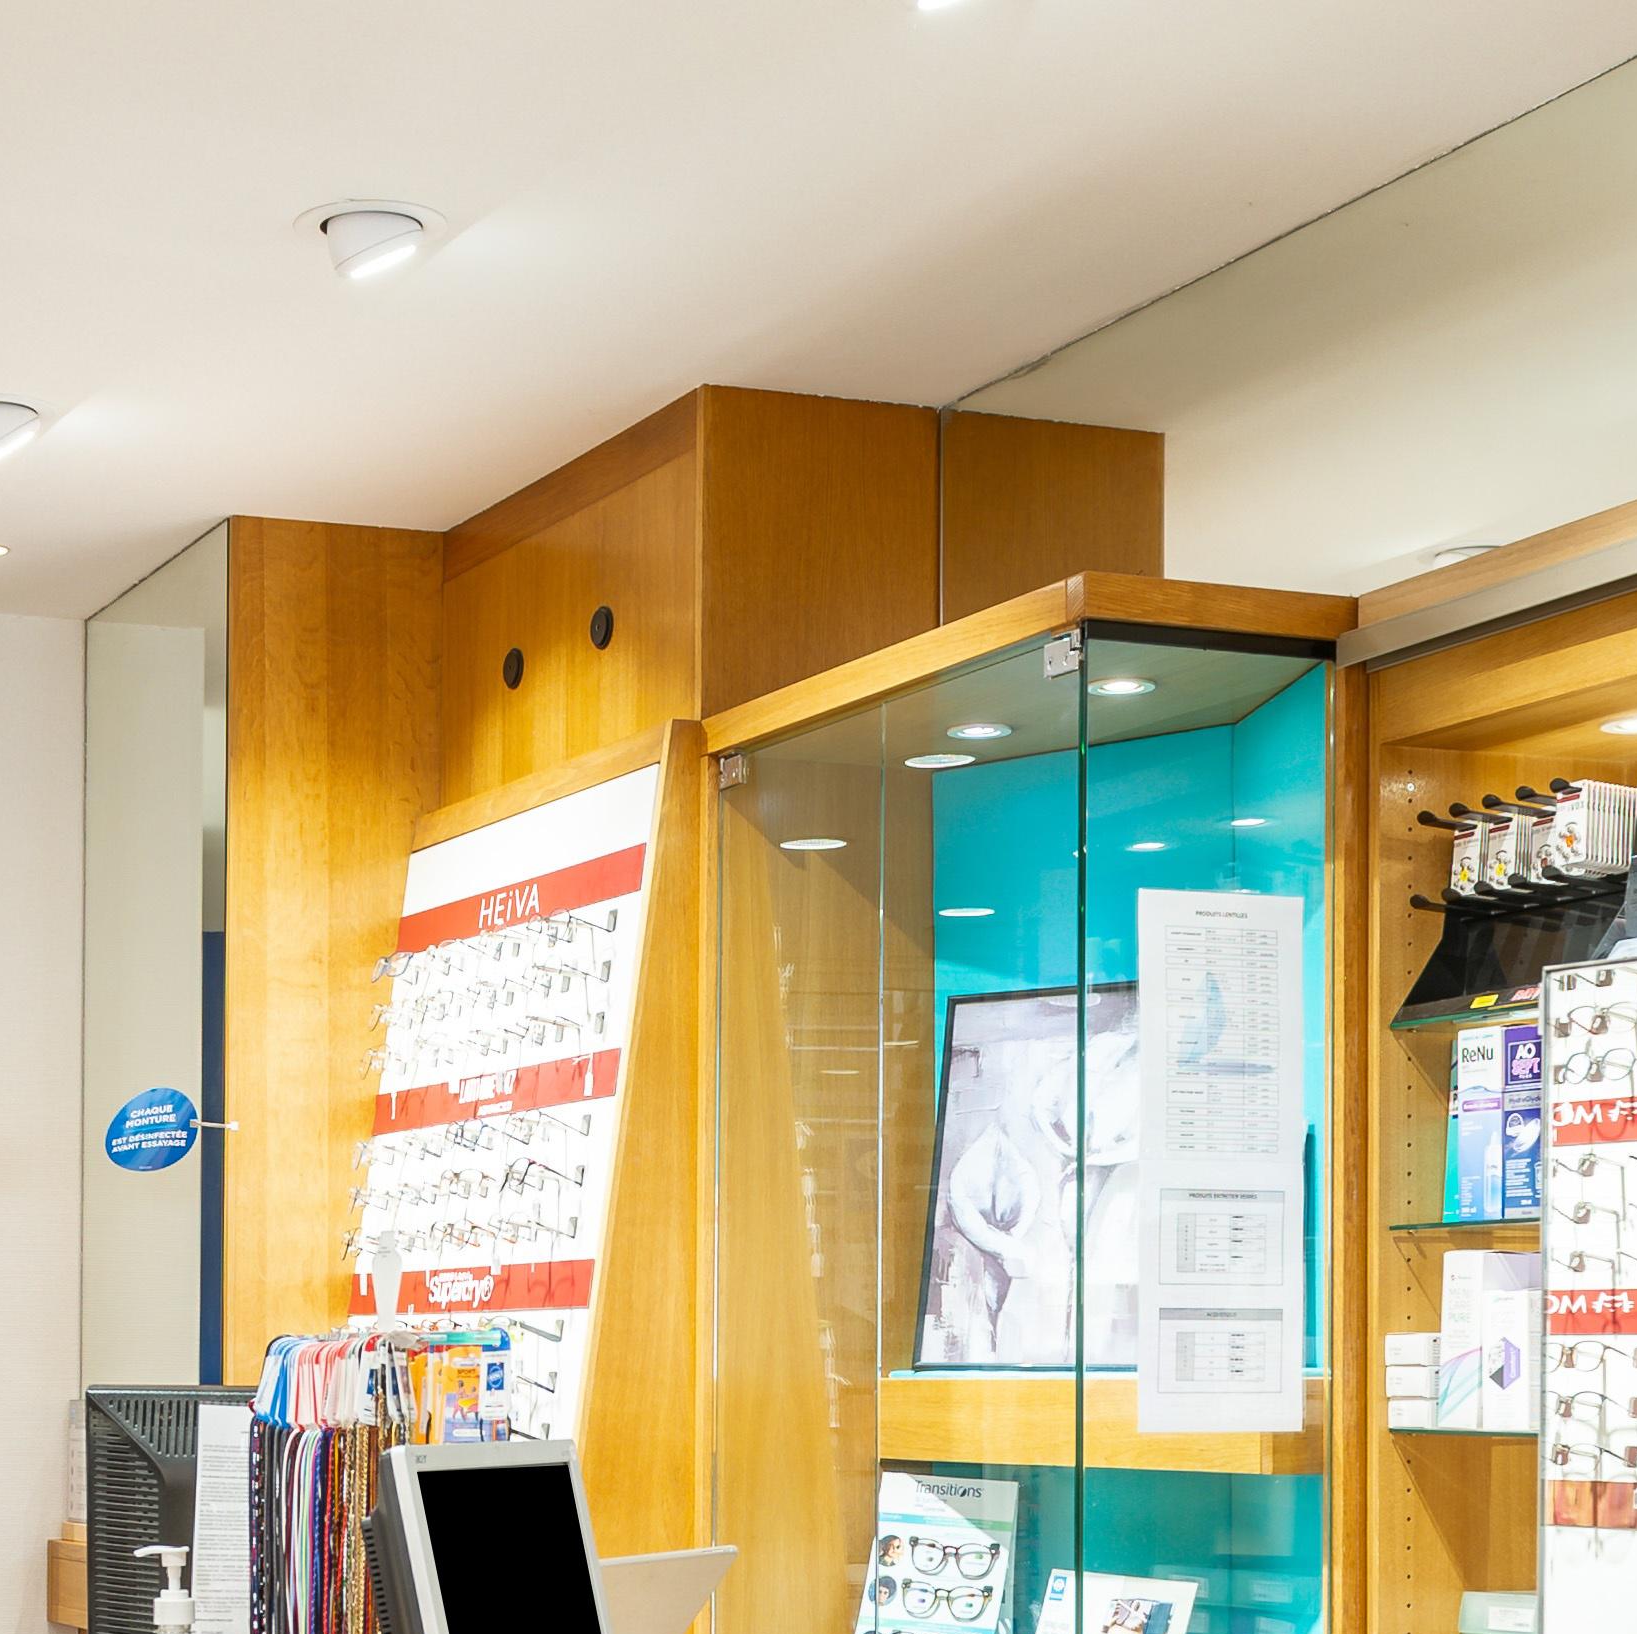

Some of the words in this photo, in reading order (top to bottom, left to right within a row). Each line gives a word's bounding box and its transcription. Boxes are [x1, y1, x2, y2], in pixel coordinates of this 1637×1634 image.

[1461, 1046, 1494, 1063] ReNu
[130, 1104, 174, 1119] CHAQUE
[125, 1113, 177, 1129] MONTURE
[111, 1136, 127, 1146] EST
[129, 1130, 188, 1142] DÉSINFECTÉE
[111, 1142, 140, 1153] AVANT
[141, 1139, 187, 1149] ESSAYAGE
[915, 1479, 983, 1498] Transitions
